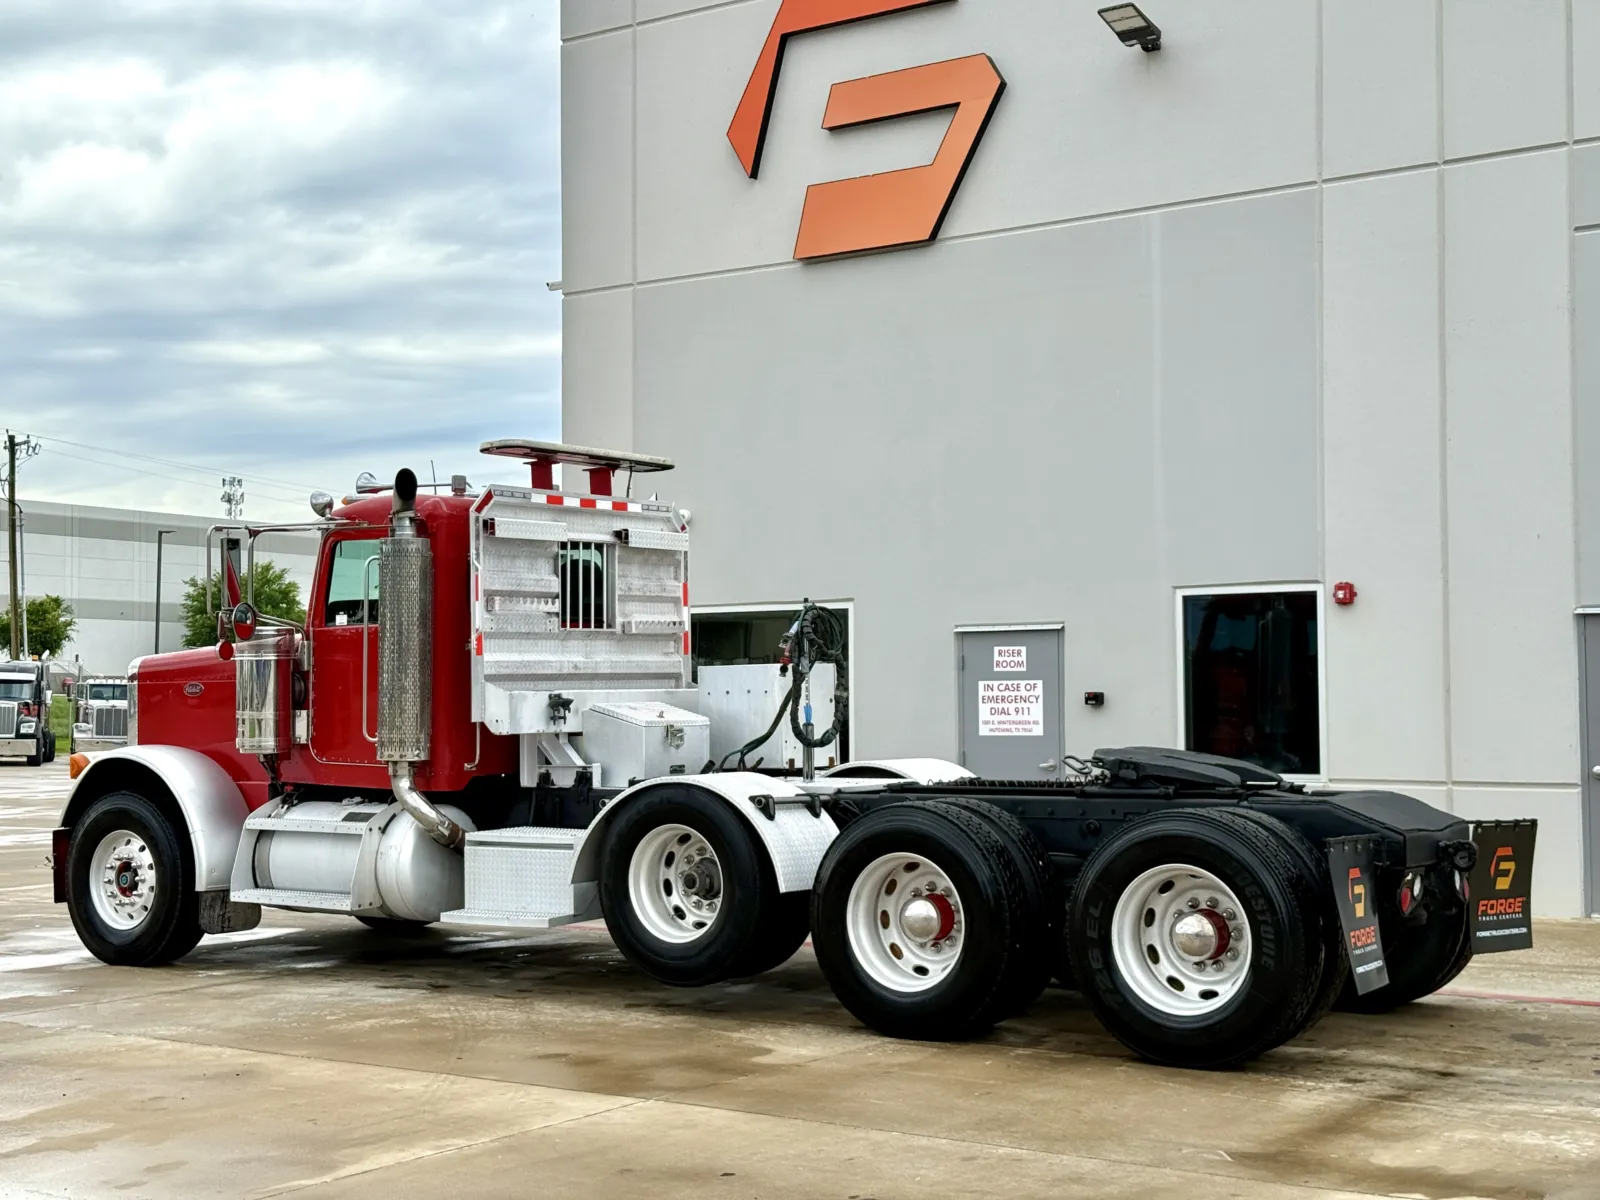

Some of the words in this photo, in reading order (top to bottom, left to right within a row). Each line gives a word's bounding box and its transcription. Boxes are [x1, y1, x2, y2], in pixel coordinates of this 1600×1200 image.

[998, 649, 1022, 658] RISER
[995, 660, 1025, 669] ROOM
[983, 683, 994, 692] IN
[997, 683, 1021, 692] CASE
[1024, 682, 1038, 692] OF
[981, 695, 1040, 704] EMERGENCY
[990, 707, 1012, 716] DIAL
[1014, 706, 1031, 716] 911
[1477, 897, 1524, 916] FORGE
[1349, 925, 1377, 949] FORGE
